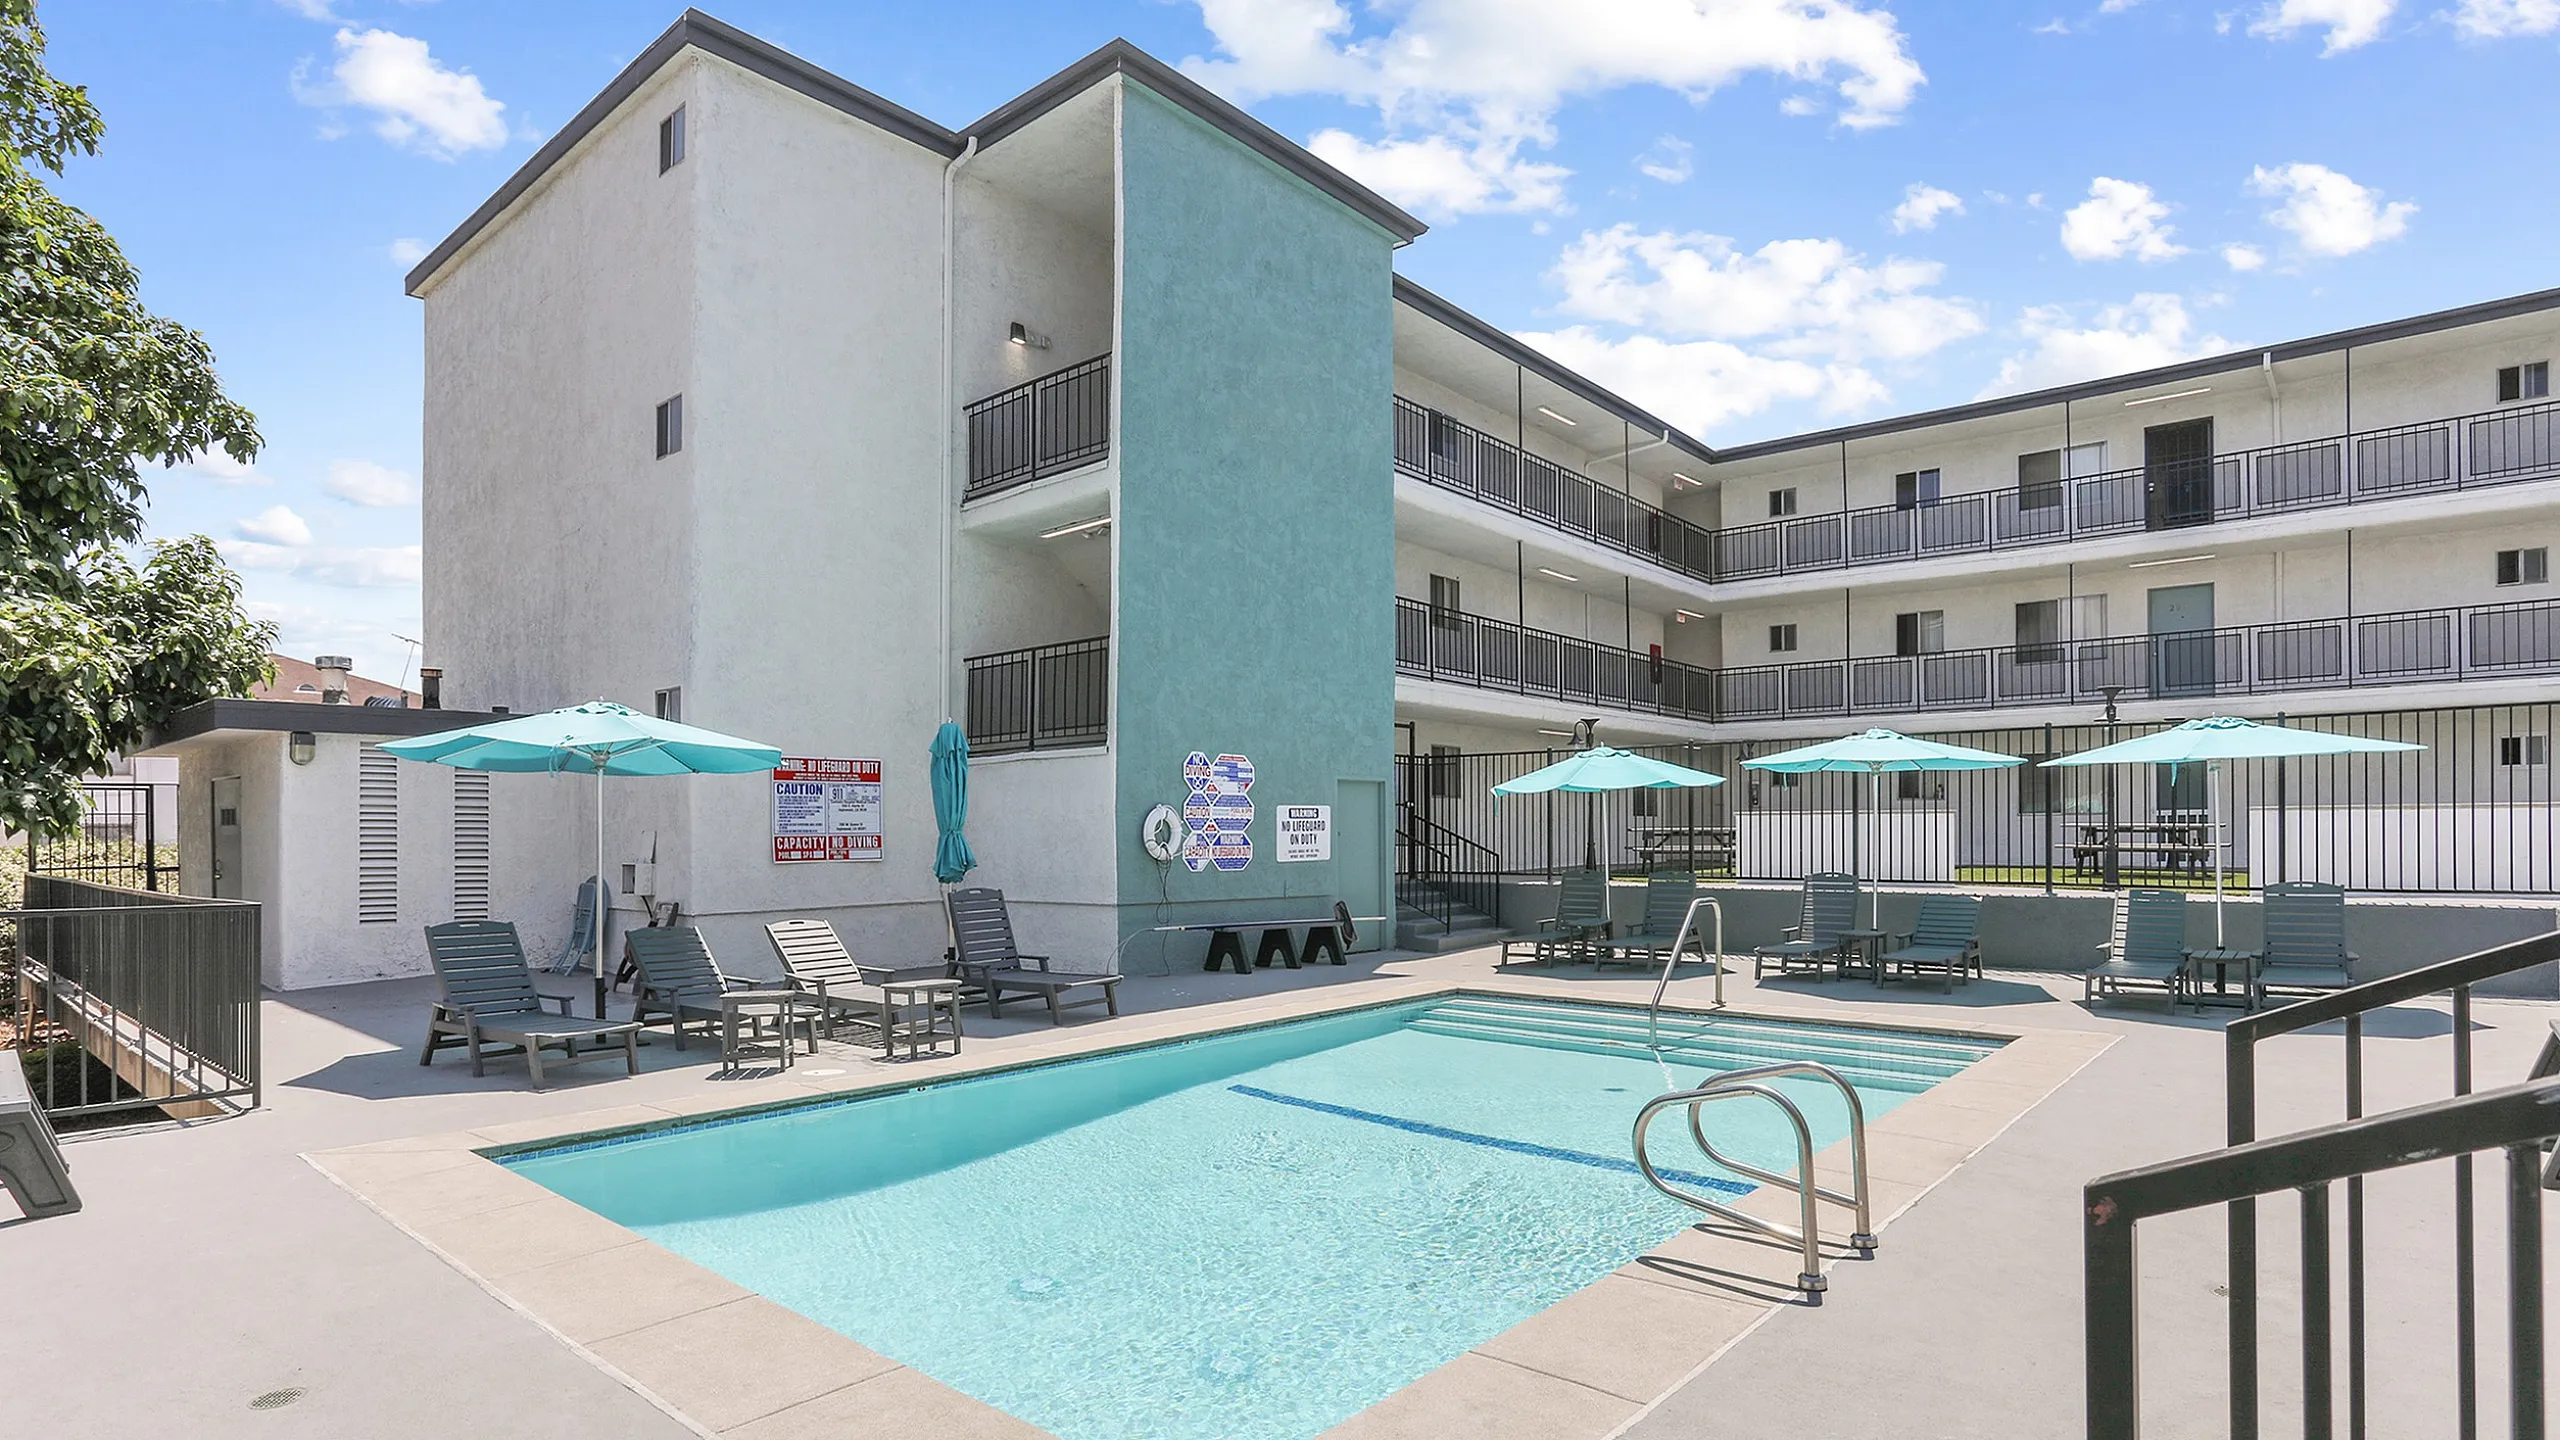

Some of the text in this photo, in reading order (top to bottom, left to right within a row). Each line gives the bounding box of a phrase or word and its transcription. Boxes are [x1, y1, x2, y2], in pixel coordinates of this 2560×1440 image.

[1193, 754, 1204, 765] NO
[808, 760, 816, 772] NO
[818, 760, 850, 773] LIFEGUARD
[852, 762, 860, 773] ON
[862, 762, 879, 774] DUTY
[1185, 765, 1211, 777] DIVING
[776, 783, 823, 795] CAUTION
[832, 788, 843, 800] 911
[1185, 807, 1210, 817] CAUTION
[1290, 809, 1317, 817] WARNING
[1281, 820, 1326, 832] NO LIFEGUARD
[777, 837, 825, 849] CAPACITY
[832, 836, 879, 848] NO DIVING
[1290, 833, 1317, 845] ON DUTY
[1184, 846, 1210, 857] CAPACITY
